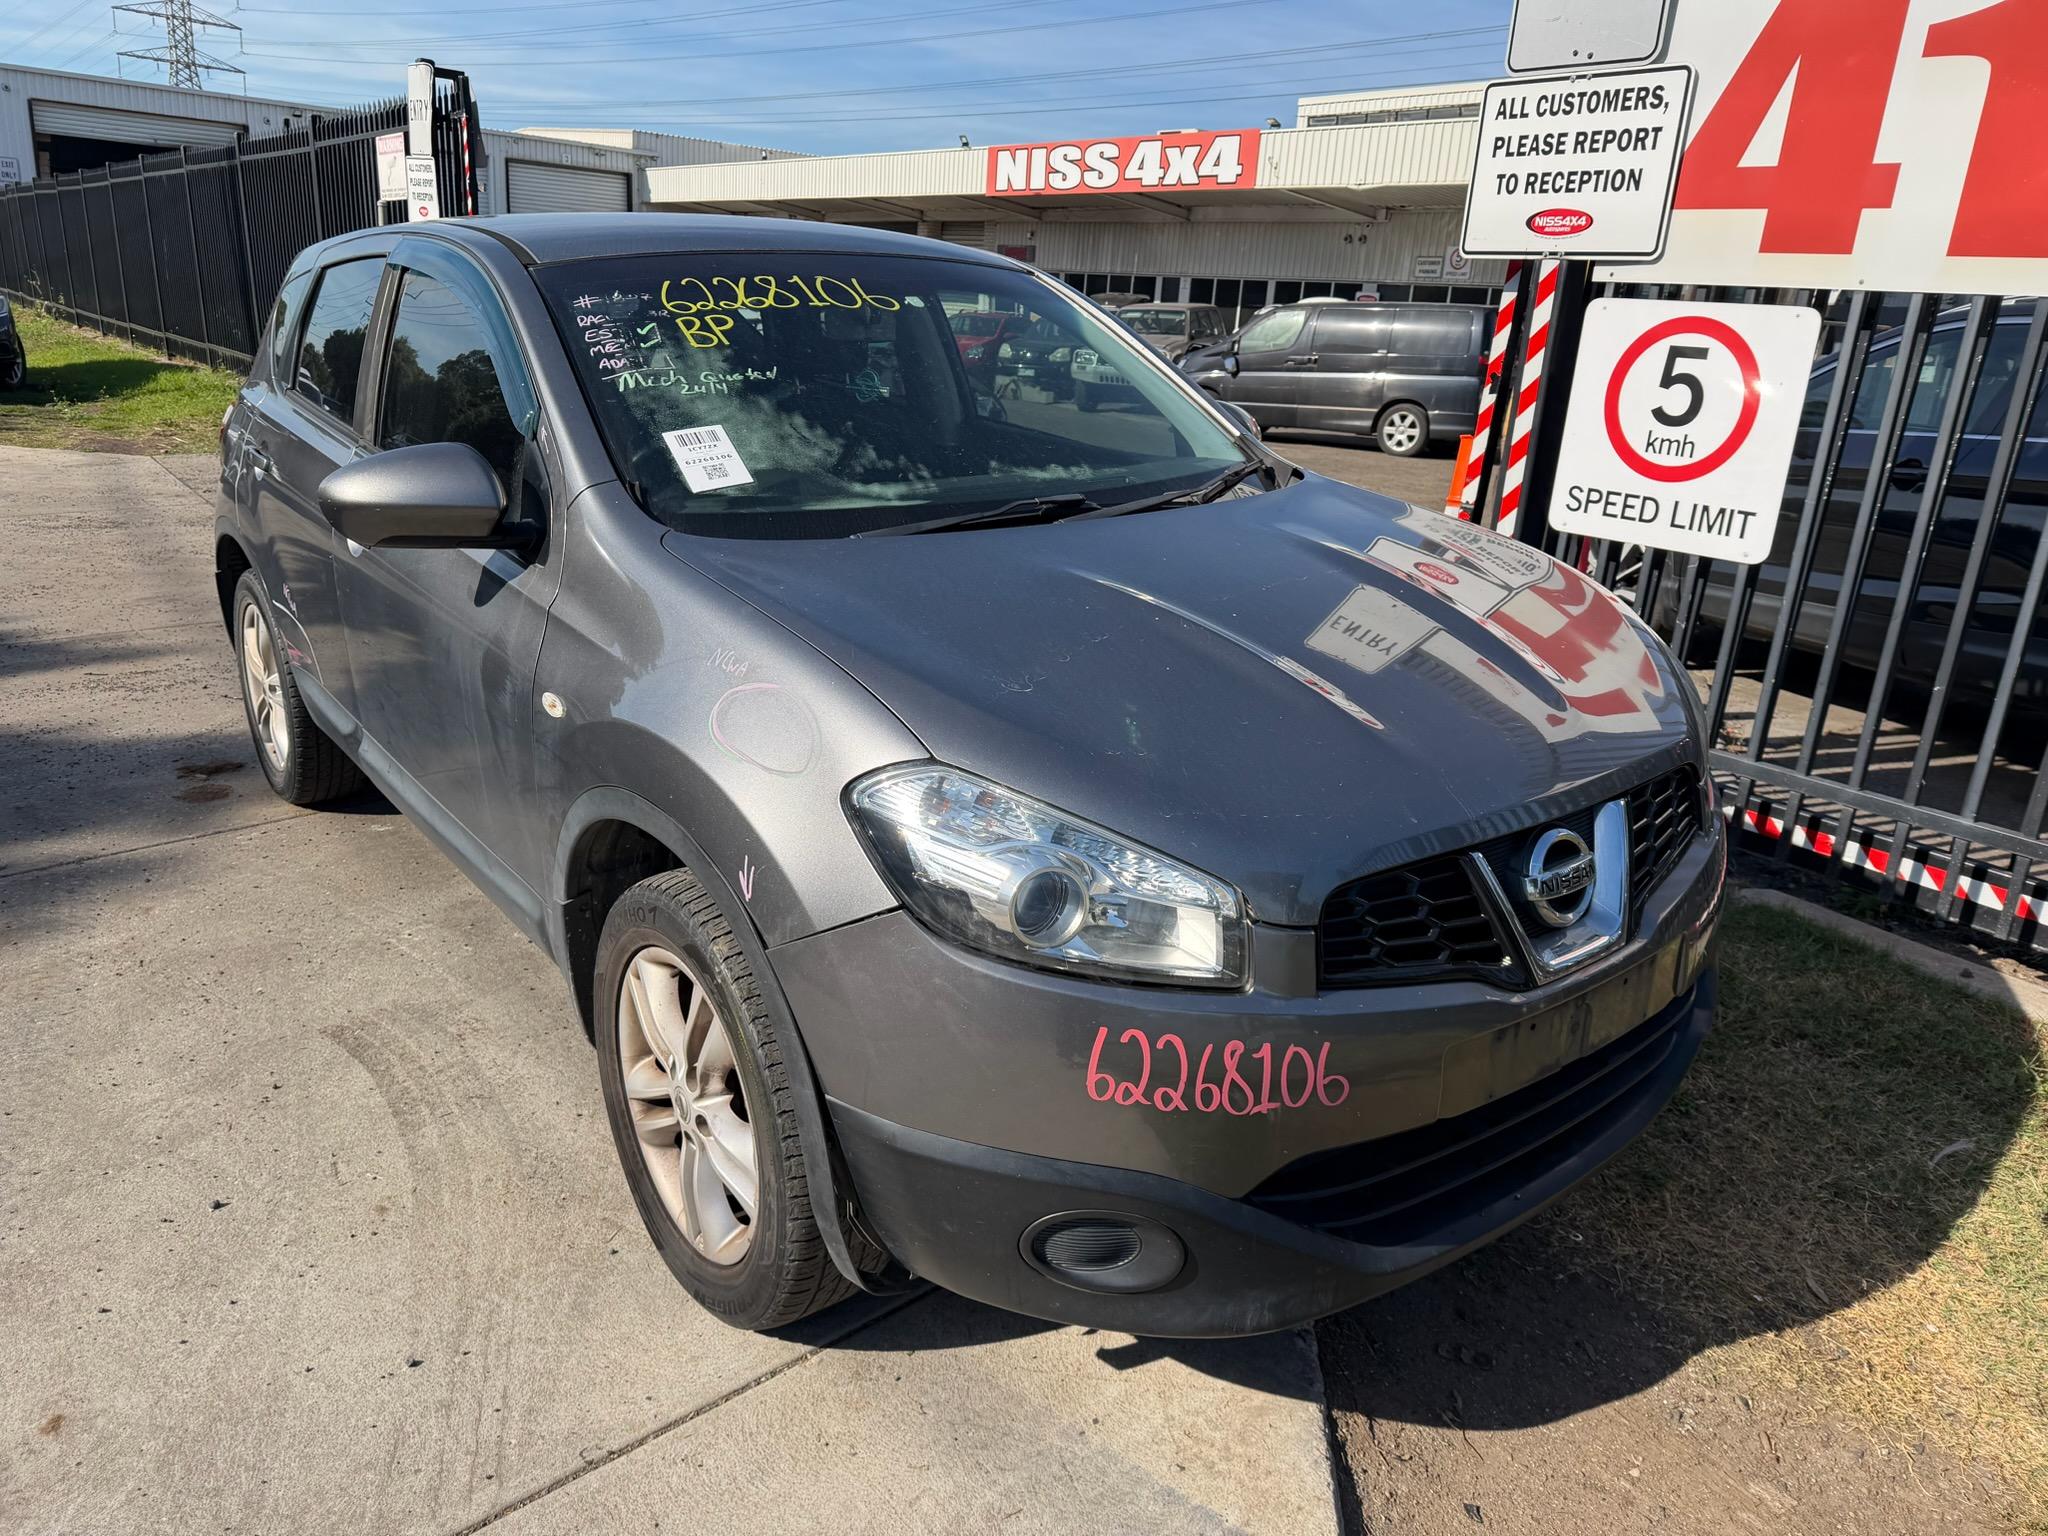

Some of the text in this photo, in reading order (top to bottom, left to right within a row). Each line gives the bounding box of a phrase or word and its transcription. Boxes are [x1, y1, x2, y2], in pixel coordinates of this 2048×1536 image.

[409, 99, 429, 121] ENTRY
[1495, 85, 1670, 120] ALL CUSTOMERS,
[1492, 127, 1663, 158] PLEASE REPORT
[1497, 168, 1643, 195] TO RECEPTION
[661, 275, 900, 314] 62268106
[675, 314, 735, 348] BP
[1650, 345, 1710, 427] 5
[1645, 430, 1696, 459] kmh
[1565, 485, 1757, 540] SPEED LIMIT
[1541, 864, 1595, 895] NISSAN
[1086, 1026, 1350, 1116] 62268106
